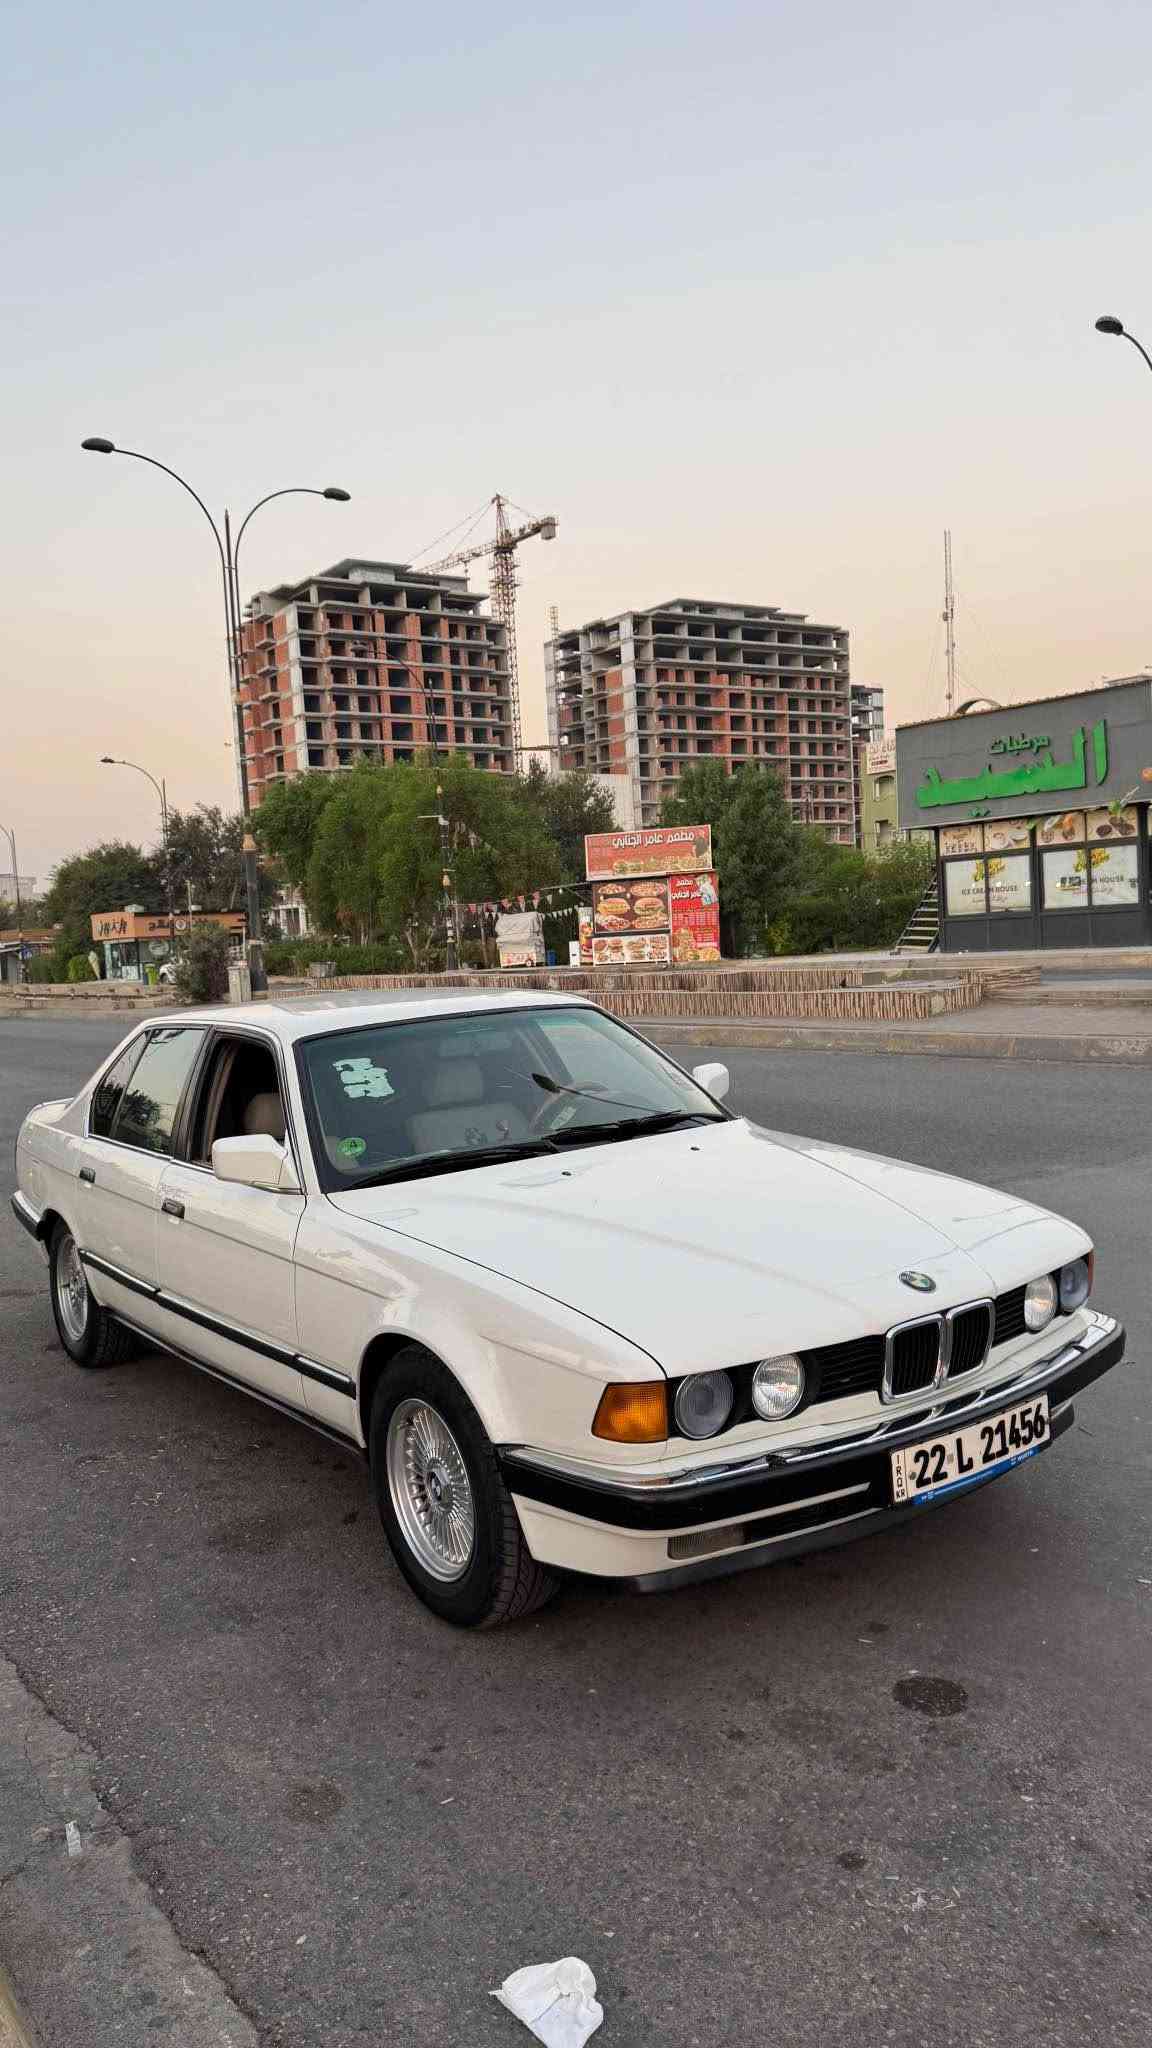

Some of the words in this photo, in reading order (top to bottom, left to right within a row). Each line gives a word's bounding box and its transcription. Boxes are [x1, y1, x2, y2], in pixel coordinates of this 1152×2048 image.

[988, 733, 1050, 755] مرطبات
[644, 833, 664, 847] عامر
[666, 830, 695, 844] مطعم
[961, 887, 971, 896] ICE
[995, 884, 1019, 893] HOUSE
[913, 1444, 948, 1488] 22
[955, 1437, 974, 1473] L
[980, 1402, 1046, 1464] 21456
